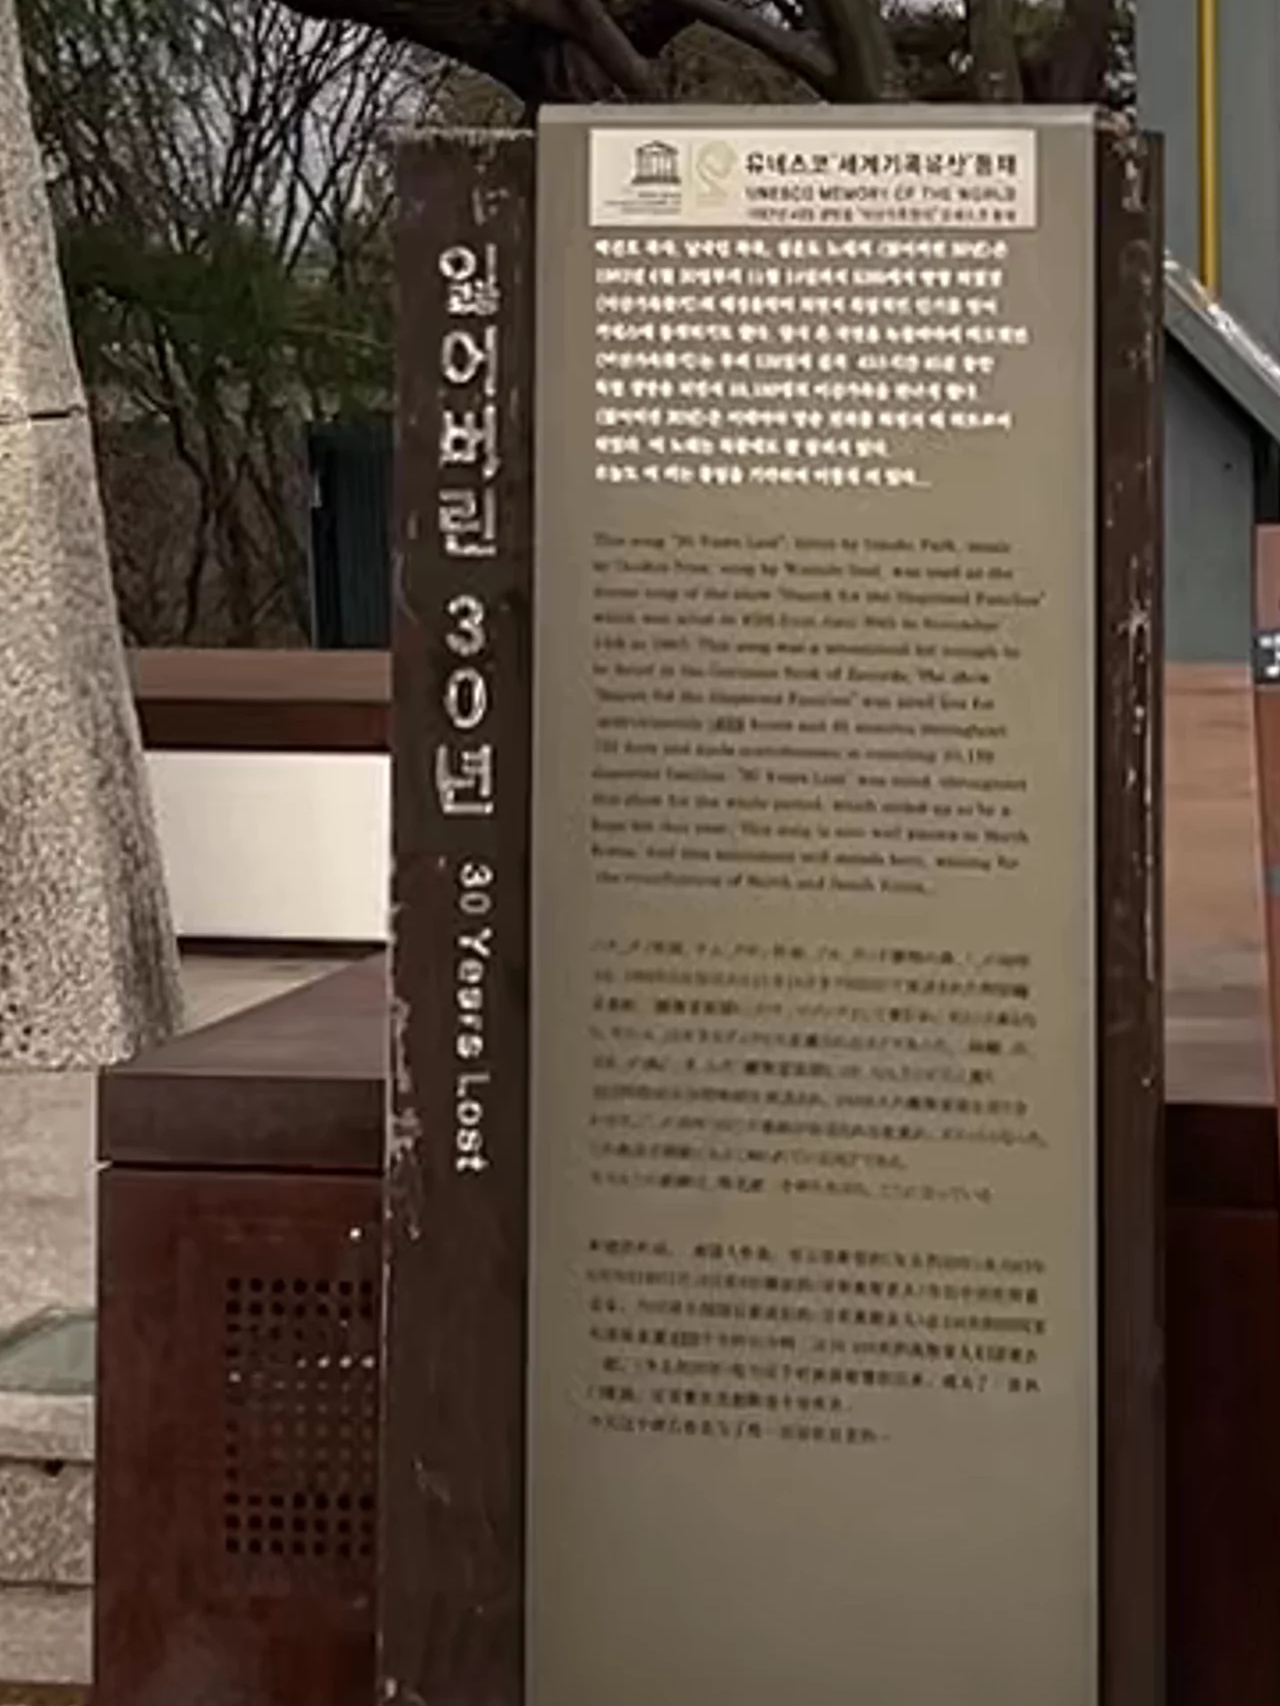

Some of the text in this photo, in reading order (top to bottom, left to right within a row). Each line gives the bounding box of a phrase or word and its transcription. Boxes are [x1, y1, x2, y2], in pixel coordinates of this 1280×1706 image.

[745, 185, 813, 201] UNESCO
[818, 186, 887, 201] MEMORY
[956, 186, 1015, 201] WORLD
[436, 244, 502, 817] 잃어버린 30년
[455, 865, 493, 1172] 30 Years Lost
